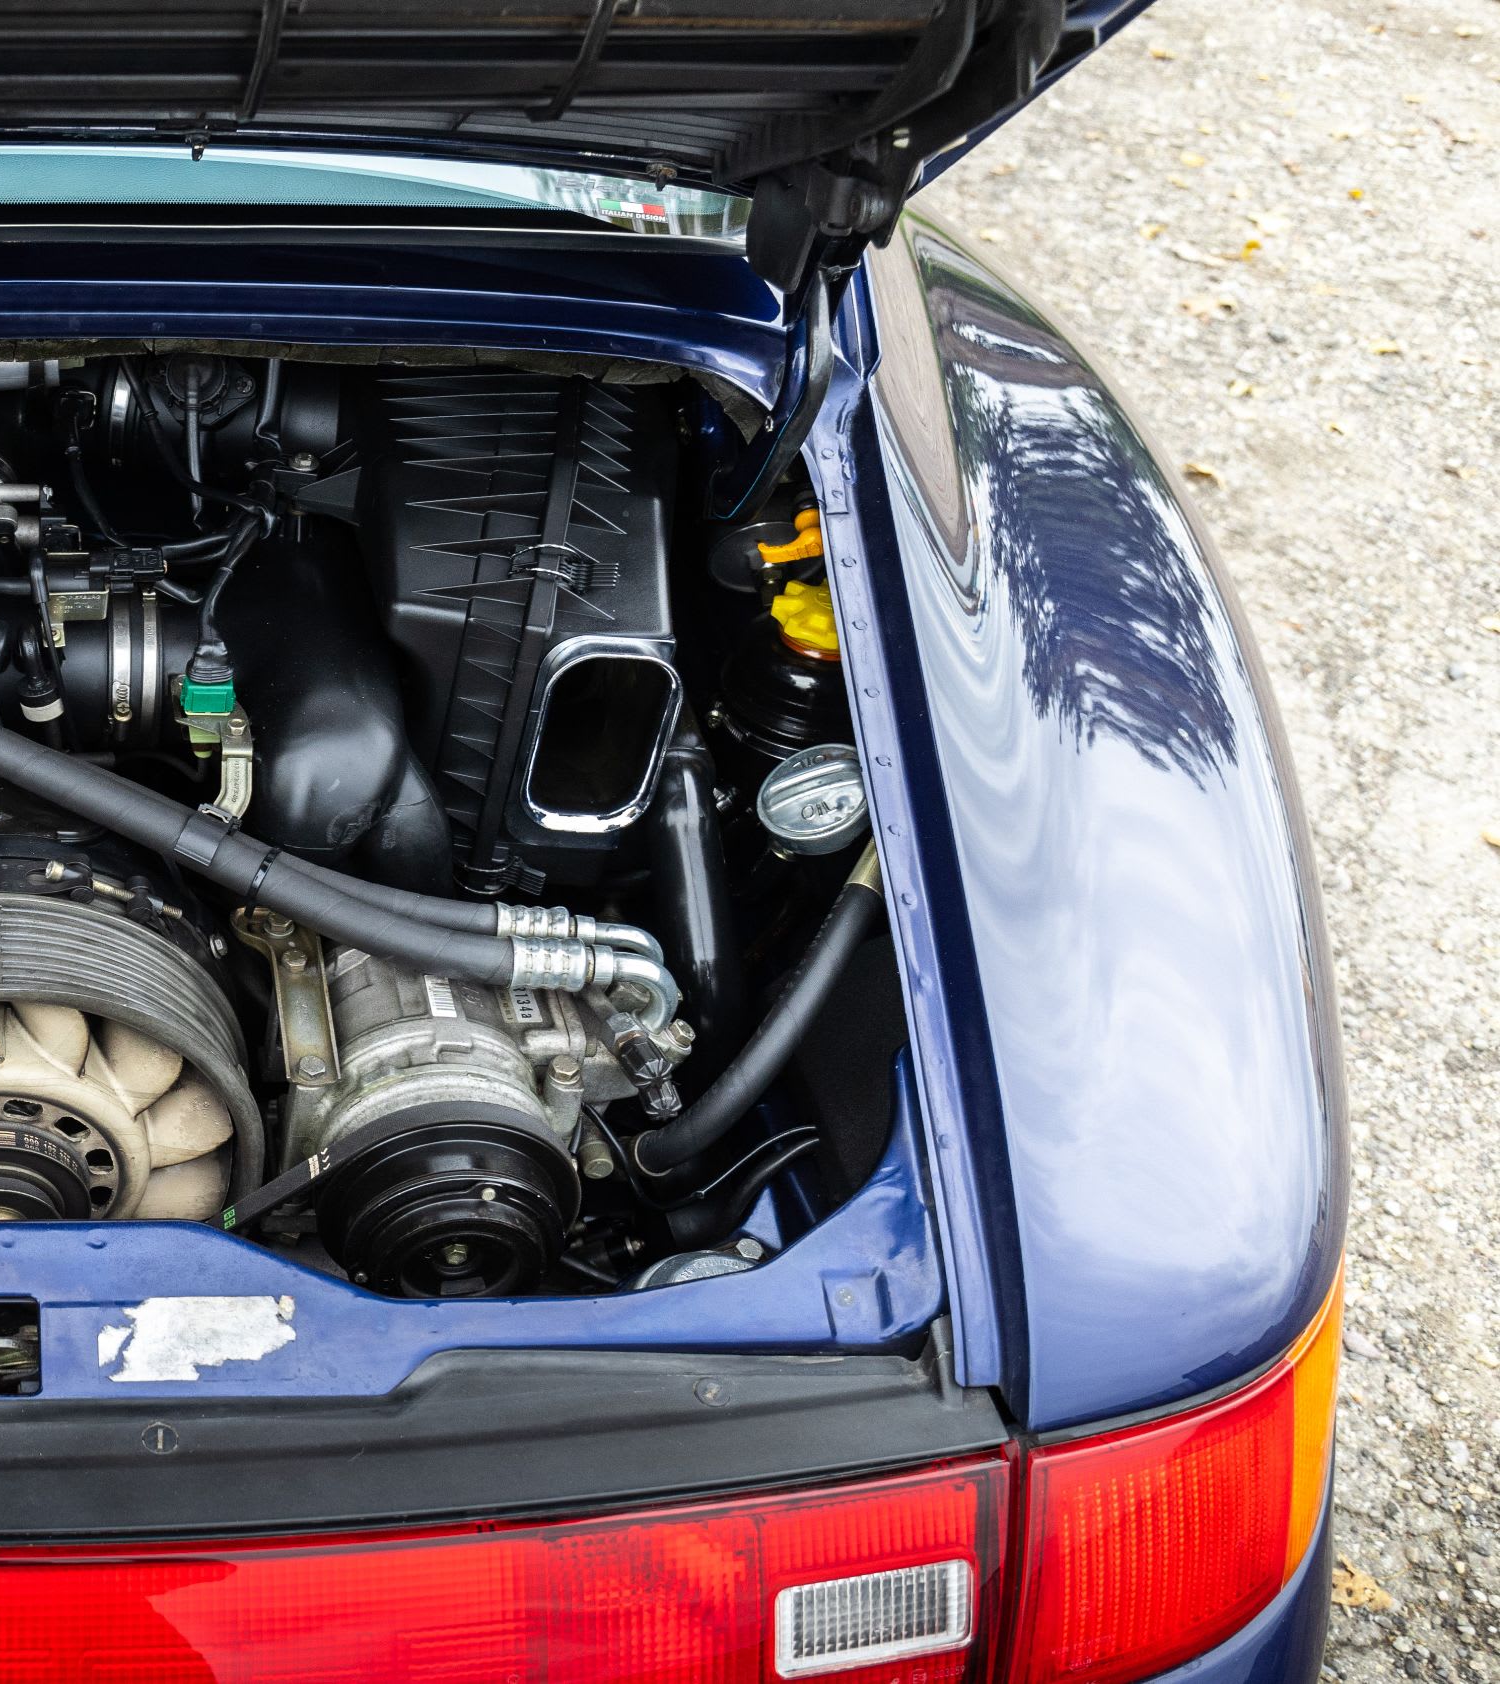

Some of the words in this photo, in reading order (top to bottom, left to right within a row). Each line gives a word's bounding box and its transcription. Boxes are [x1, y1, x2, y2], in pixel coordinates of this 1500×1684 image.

[601, 209, 634, 219] ITALIAN
[635, 213, 667, 223] DESIGN
[801, 801, 838, 821] OIL
